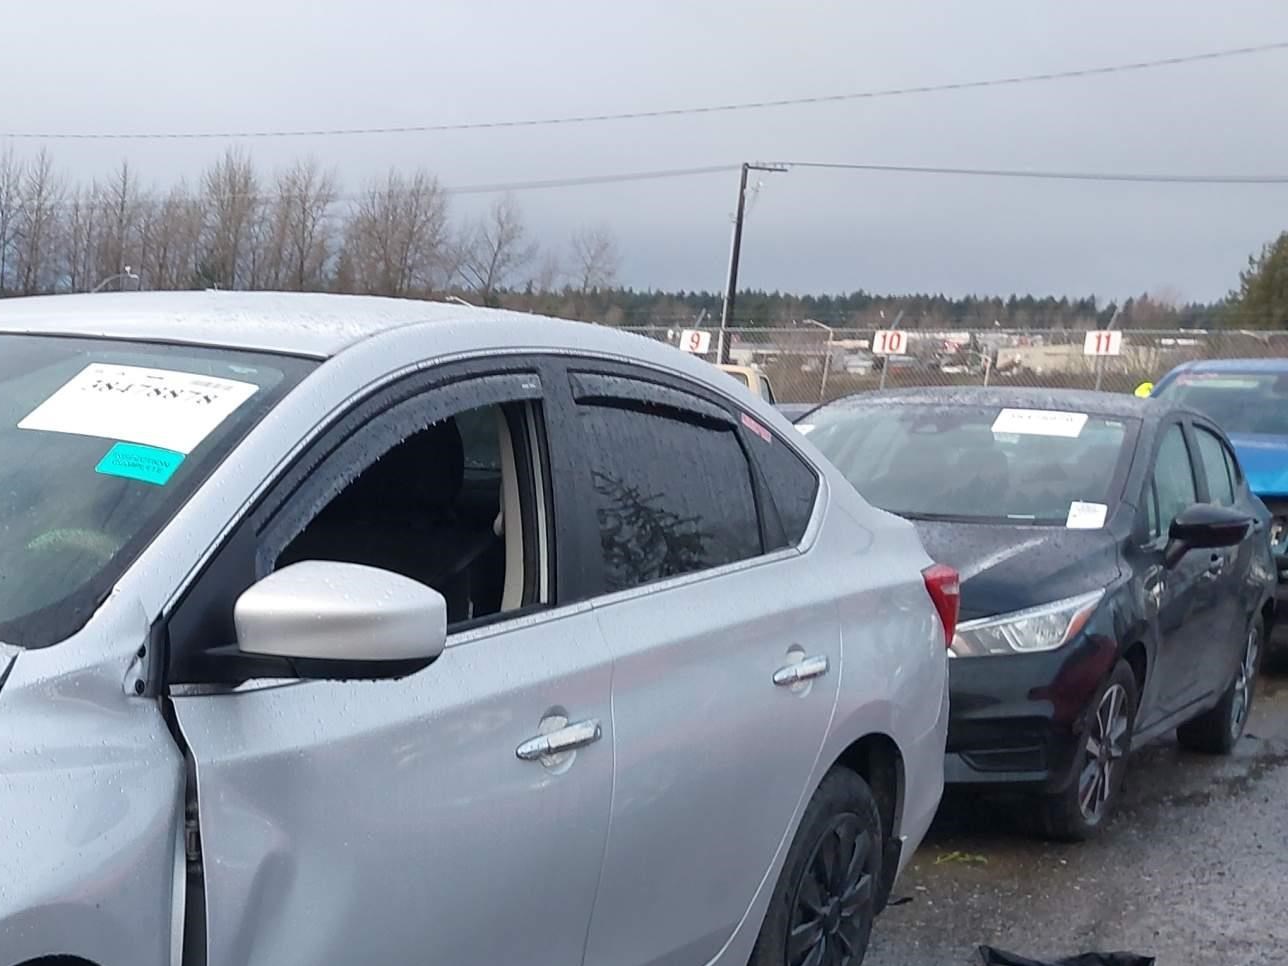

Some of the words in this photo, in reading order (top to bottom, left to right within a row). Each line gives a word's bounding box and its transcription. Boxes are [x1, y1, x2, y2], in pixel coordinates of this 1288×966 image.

[690, 333, 700, 350] 9
[880, 332, 901, 352] 10
[1095, 333, 1111, 353] 11
